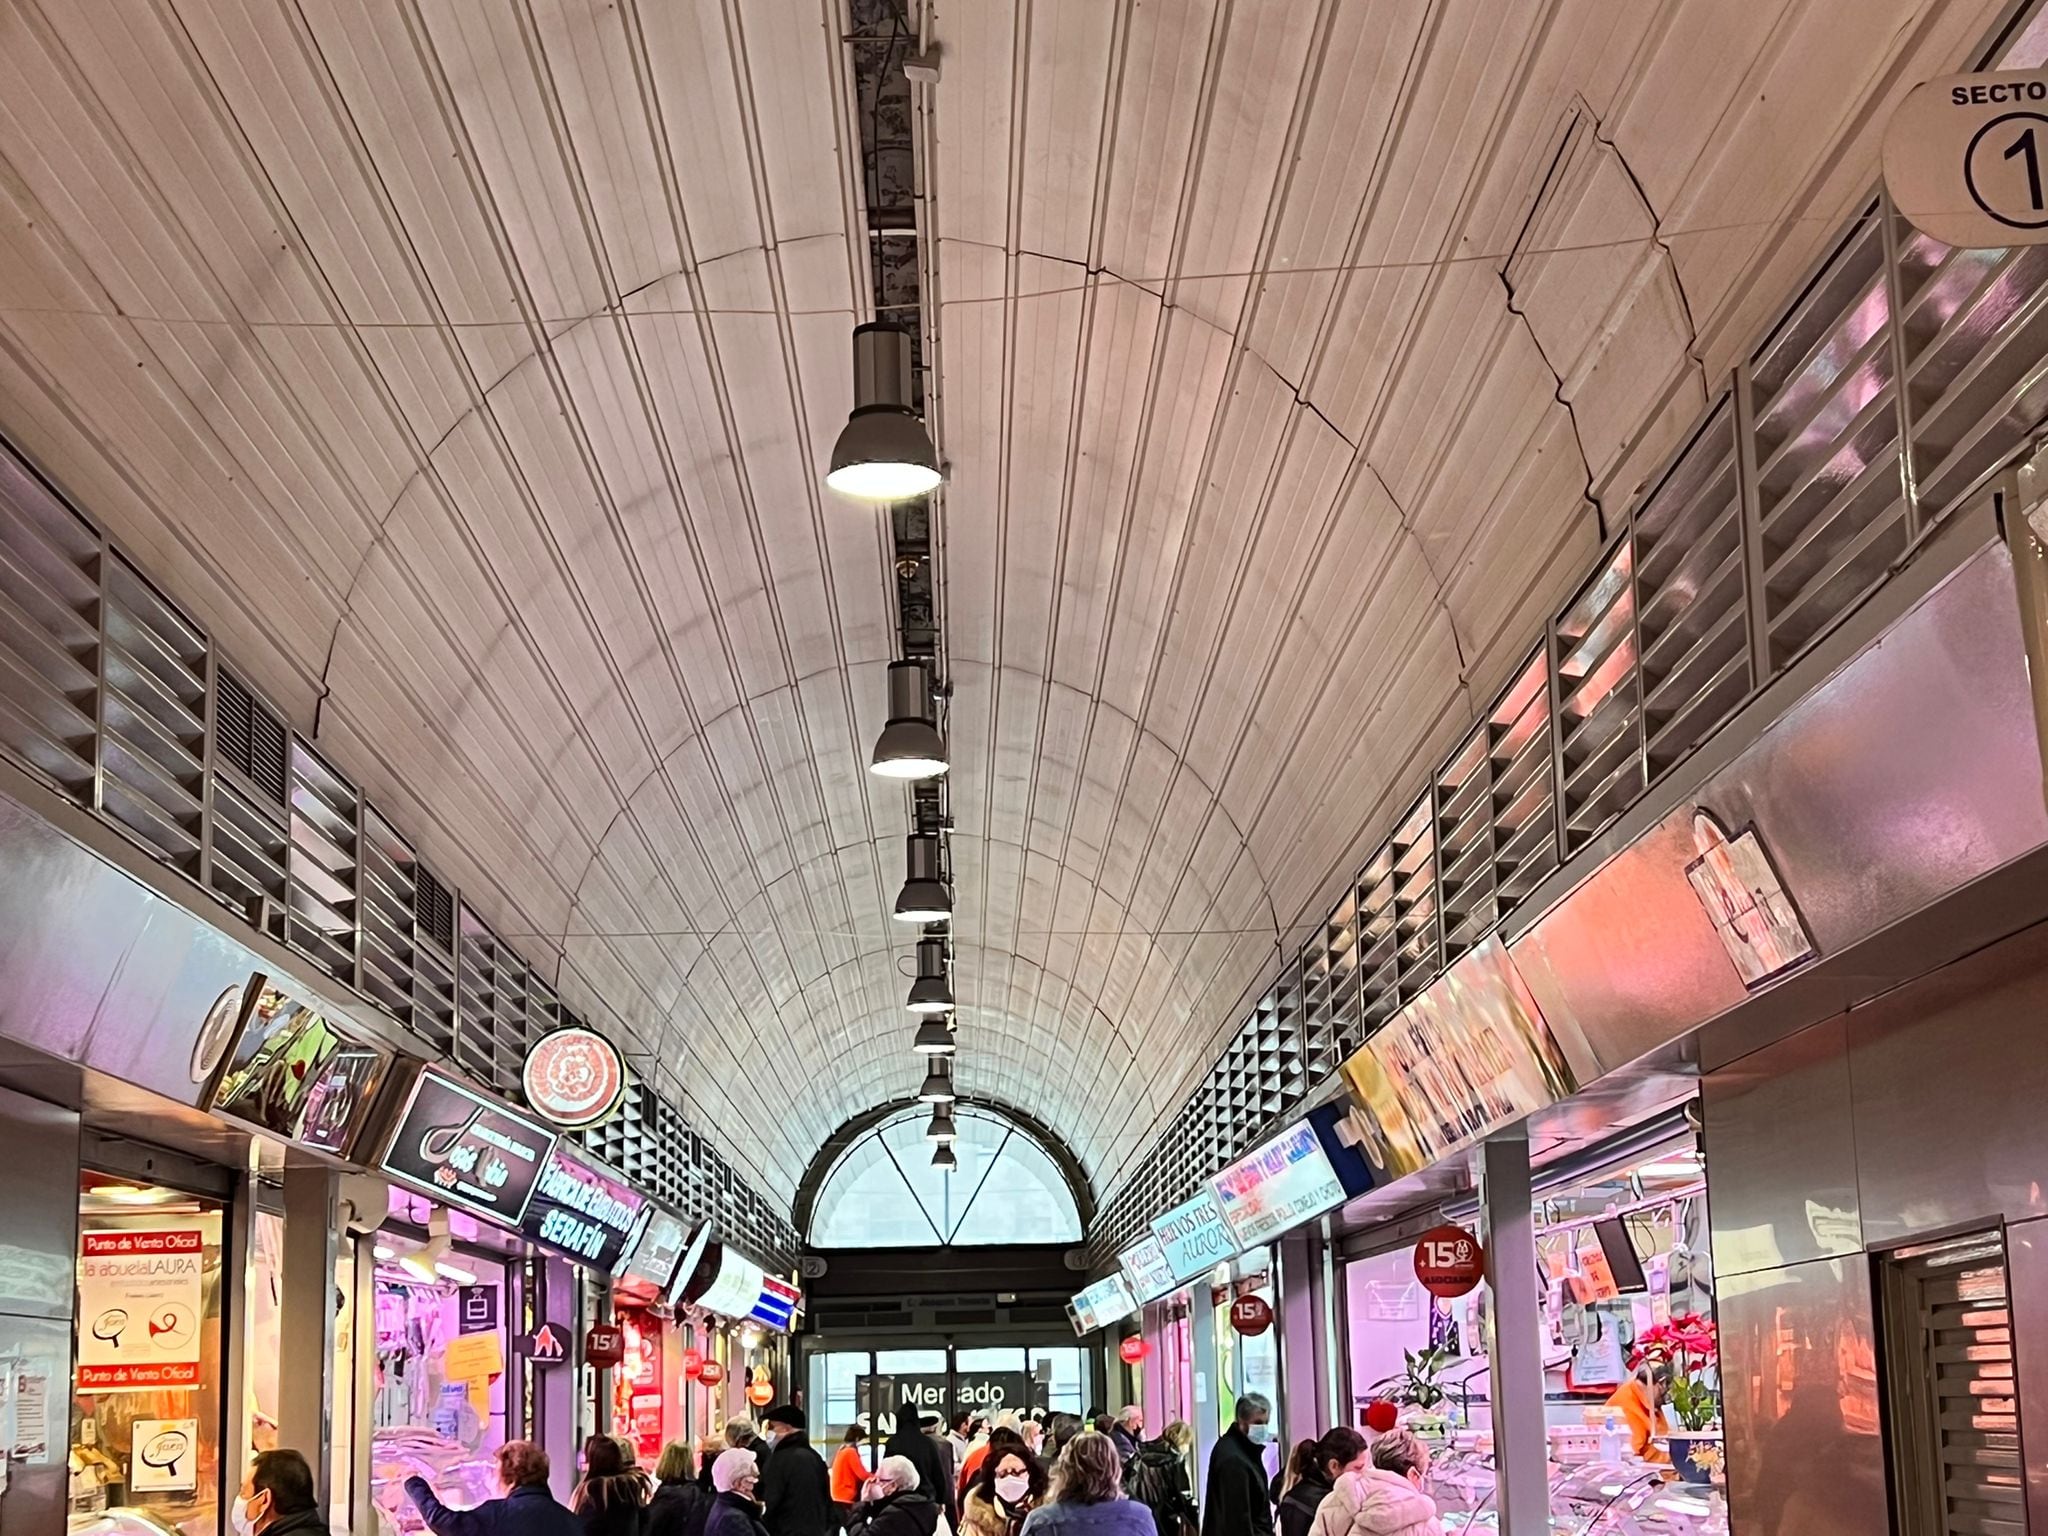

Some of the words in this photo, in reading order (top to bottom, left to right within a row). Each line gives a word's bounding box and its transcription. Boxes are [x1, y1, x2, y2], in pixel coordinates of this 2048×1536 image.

[2003, 128, 2044, 210] 1
[540, 1209, 607, 1260] SERAFÍN
[1157, 1212, 1197, 1246] HUEVOS
